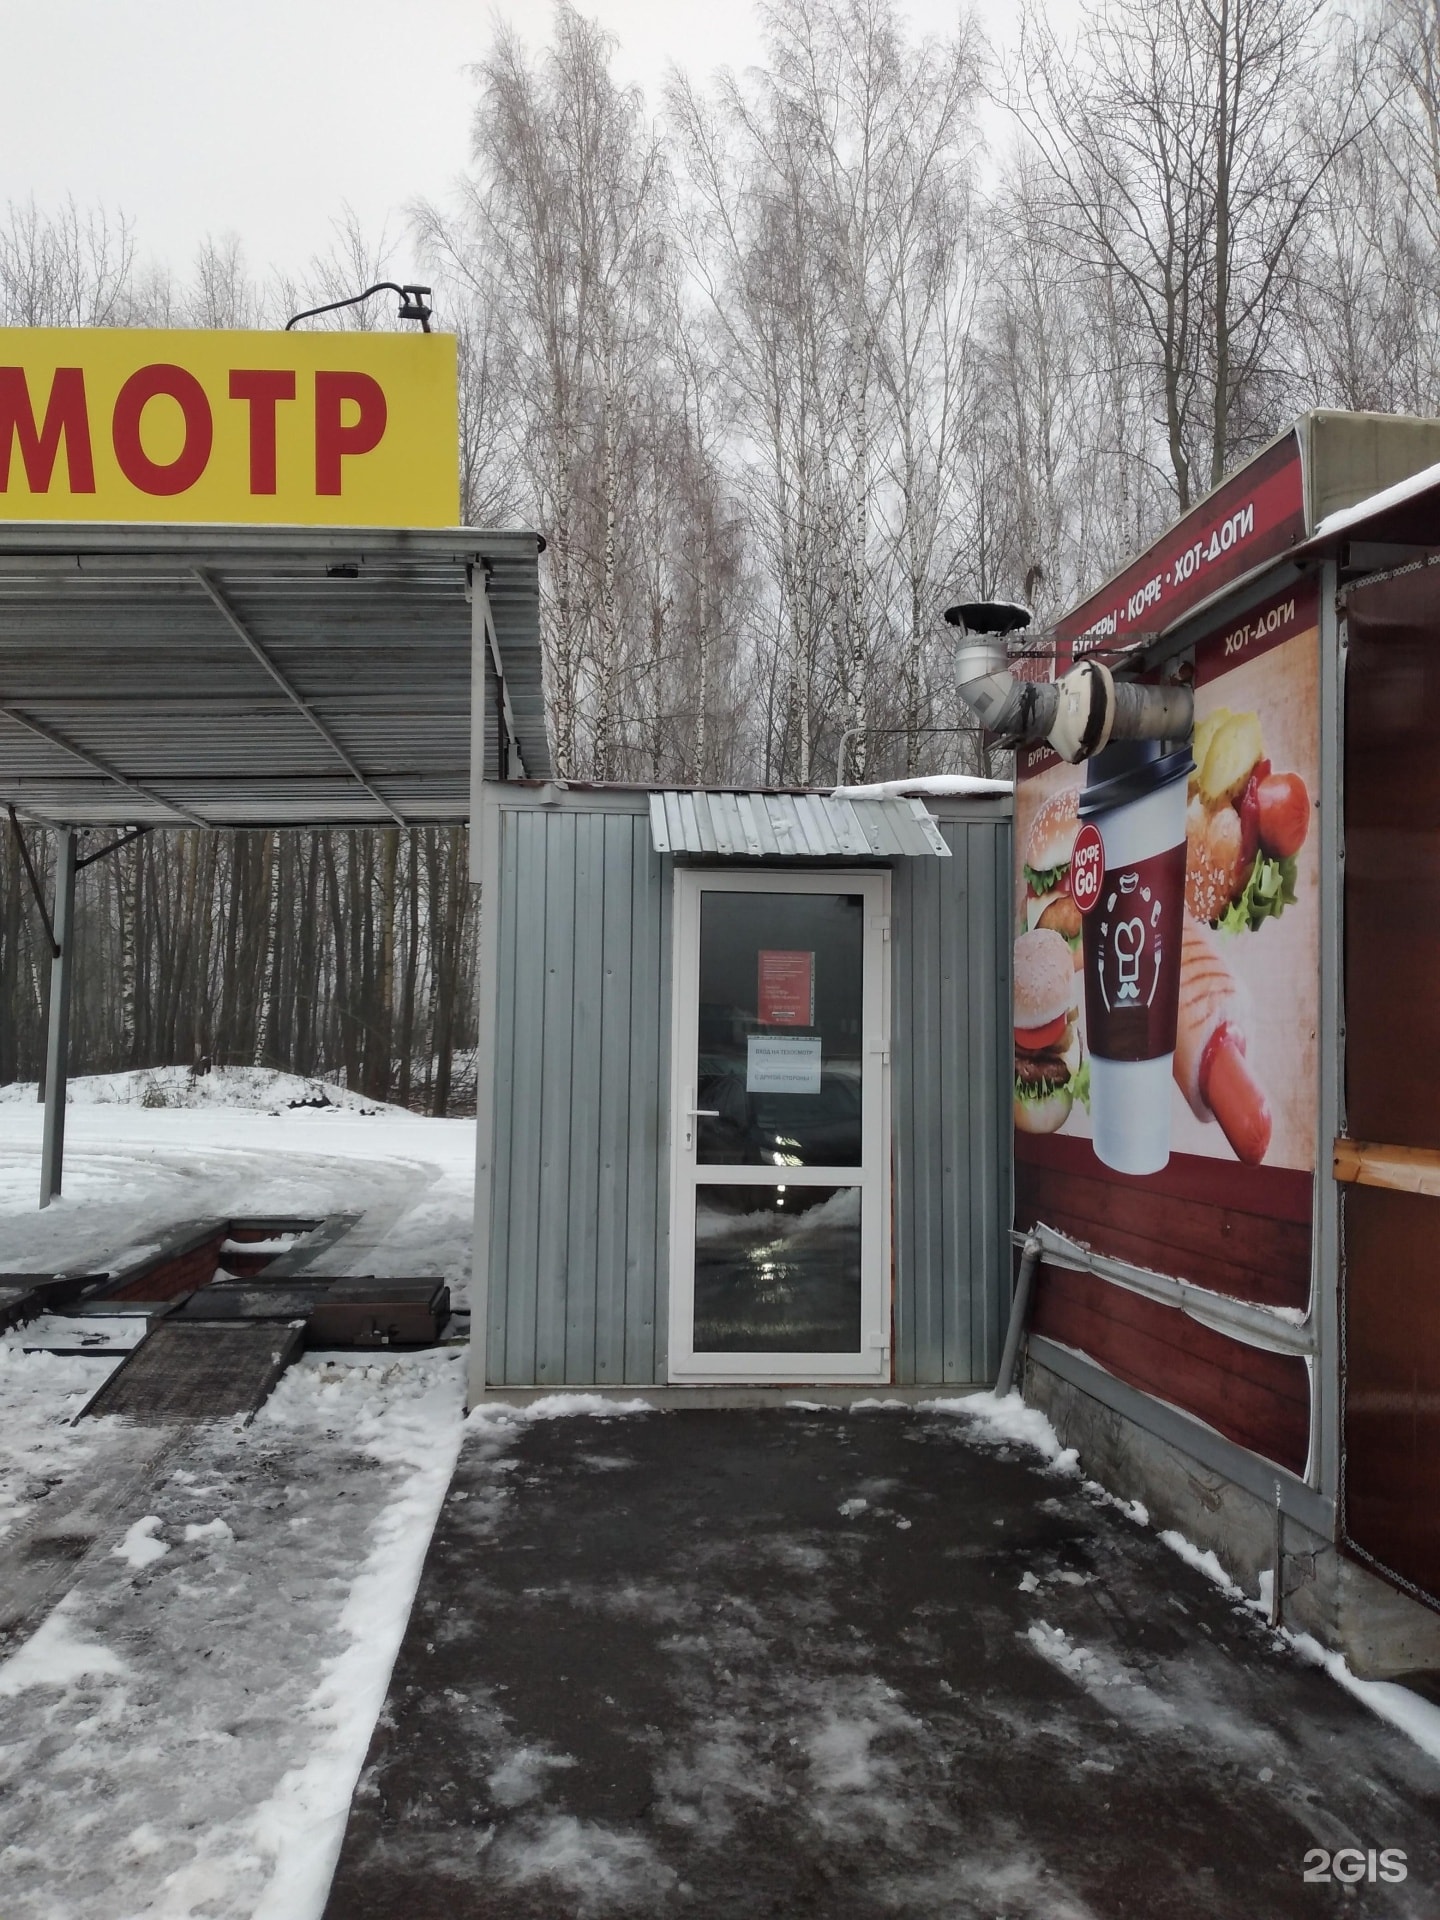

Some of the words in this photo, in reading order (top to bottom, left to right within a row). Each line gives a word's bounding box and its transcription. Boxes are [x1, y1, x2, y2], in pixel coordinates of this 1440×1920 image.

[0, 363, 387, 496] МОТР
[1127, 574, 1162, 622] КОФЕ
[1174, 503, 1254, 586] ХОТ-ДОГИ
[1225, 599, 1295, 657] ХОТ-ДОГИ
[1075, 844, 1100, 868] КОФЕ
[1075, 863, 1098, 897] Go!
